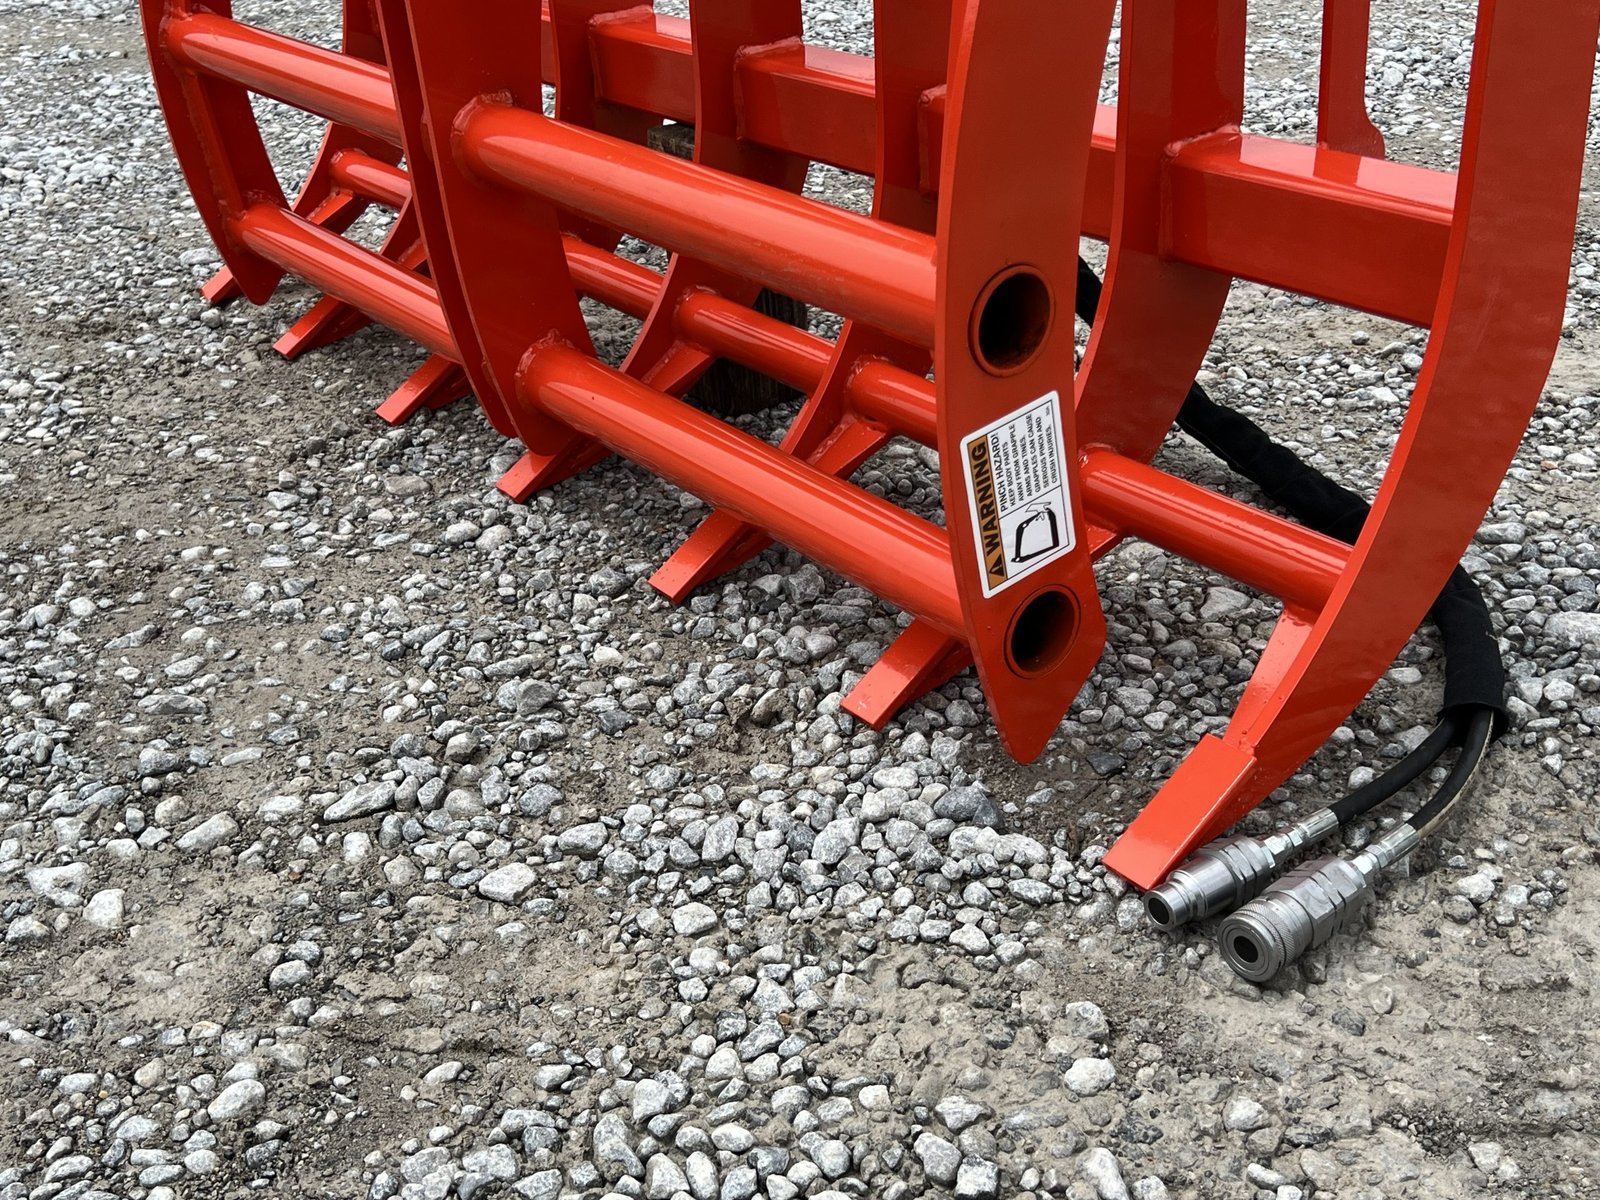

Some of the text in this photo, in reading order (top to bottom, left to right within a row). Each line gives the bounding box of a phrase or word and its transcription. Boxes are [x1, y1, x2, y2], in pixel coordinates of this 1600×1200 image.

[1025, 413, 1033, 438] CAUSE
[1001, 440, 1010, 466] PARTS
[1037, 433, 1045, 456] PINCH
[990, 432, 1008, 512] PINCH HAZARD!
[1008, 423, 1024, 502] AWAY FROM GRAPPLE
[1031, 454, 1040, 493] GRAPPLES
[1040, 456, 1049, 488] SERIOUS
[1049, 458, 1057, 483] CRUSH
[970, 440, 1000, 556] WARNING
[1024, 474, 1032, 497] ARMS
